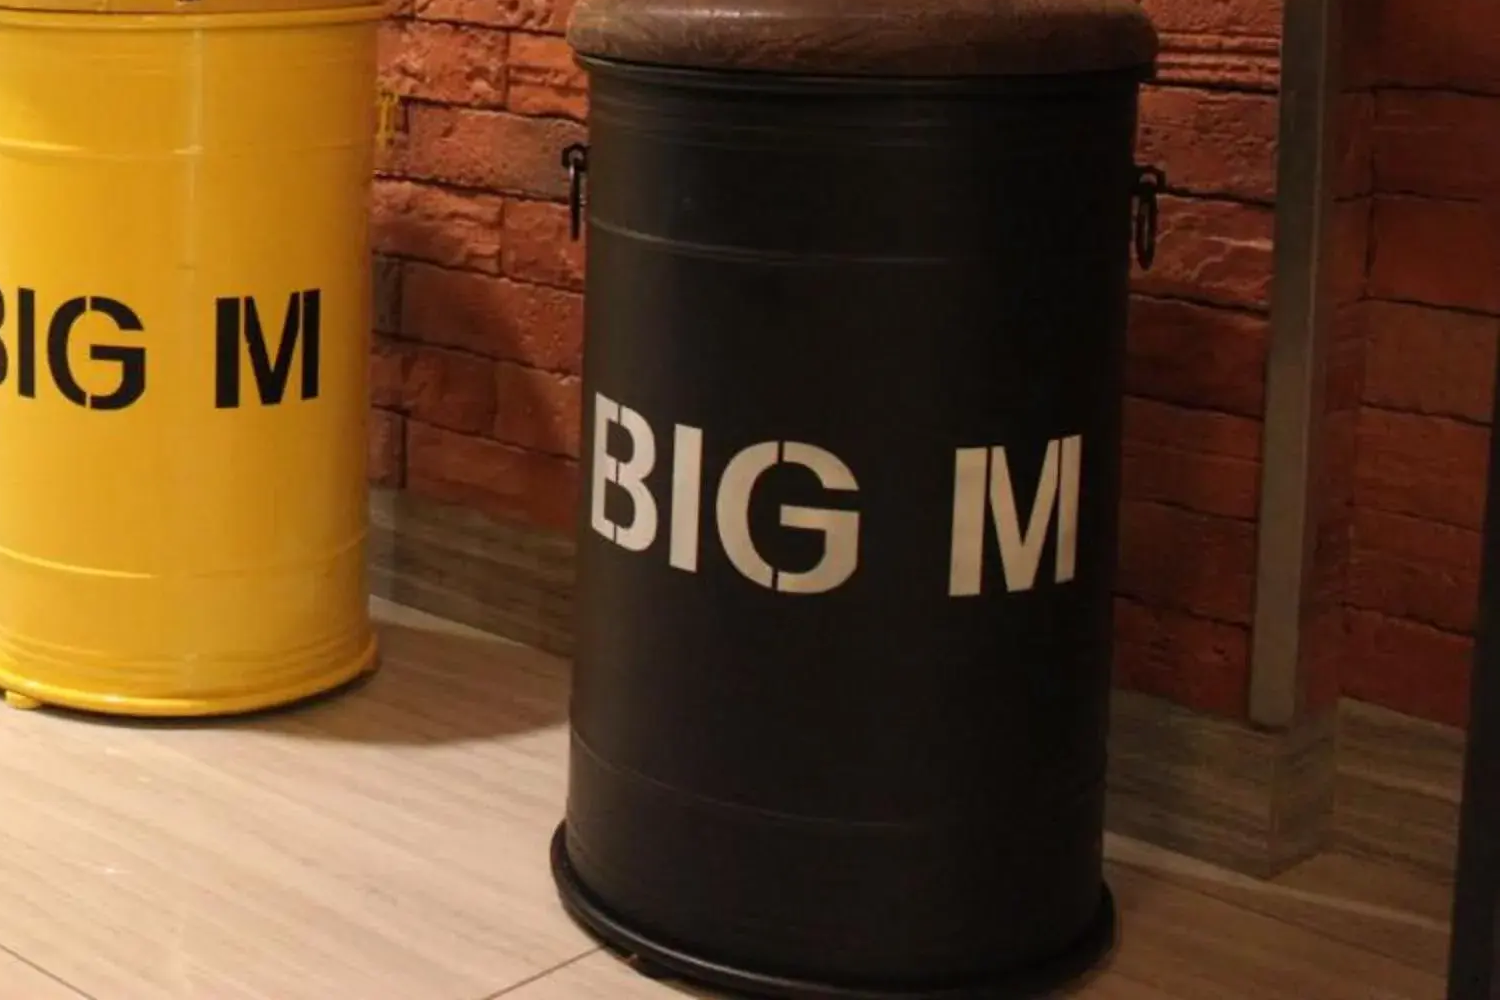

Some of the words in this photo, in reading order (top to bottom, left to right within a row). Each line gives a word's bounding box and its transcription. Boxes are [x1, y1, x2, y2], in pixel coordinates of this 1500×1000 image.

[214, 288, 321, 409] M
[591, 391, 860, 594] BIG
[948, 433, 1082, 596] M
